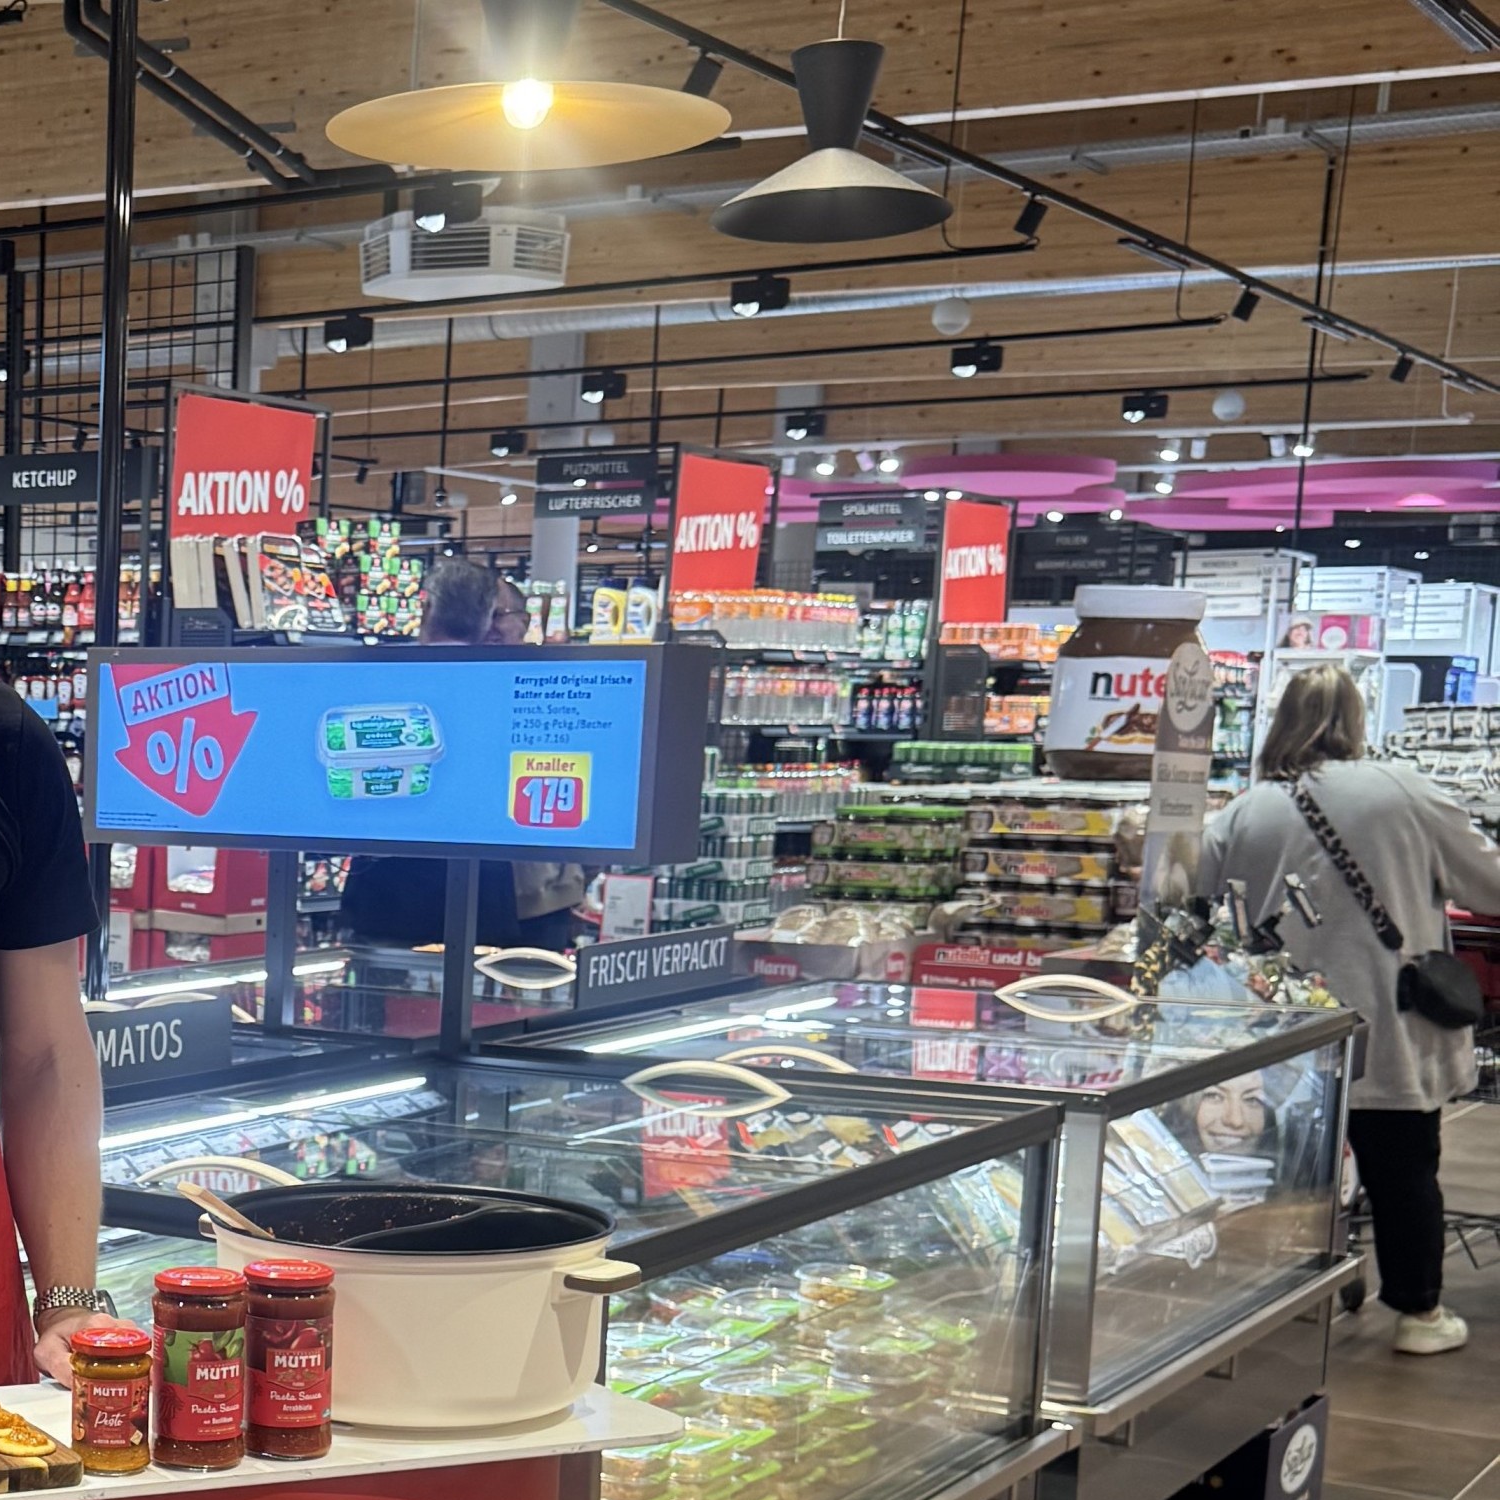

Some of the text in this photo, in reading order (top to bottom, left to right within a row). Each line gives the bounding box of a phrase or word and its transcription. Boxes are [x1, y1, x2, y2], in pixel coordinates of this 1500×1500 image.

[562, 461, 630, 476] PUTZMITTEL
[12, 469, 77, 489] KETCHUP
[178, 468, 305, 515] AKTION %
[841, 502, 903, 517] SPÜLMITTEL
[674, 512, 758, 553] AKTION %
[826, 529, 915, 545] TOILETTENPAPIER
[945, 546, 987, 580] AKTION
[561, 674, 598, 687] Original
[1089, 667, 1168, 698] nute
[132, 666, 217, 716] AKTION
[526, 757, 576, 773] Knaller
[522, 778, 575, 825] 1.79
[588, 936, 728, 988] FRISCH VERPACKT
[992, 951, 1022, 965] und
[753, 957, 798, 980] Harry
[274, 1354, 321, 1368] MUTTI
[195, 1364, 240, 1381] MUTTI
[93, 1386, 128, 1397] MUTTI
[269, 1390, 323, 1401] Pasta Sauce
[191, 1404, 218, 1414] Pasta
[94, 1410, 127, 1428] Pesto
